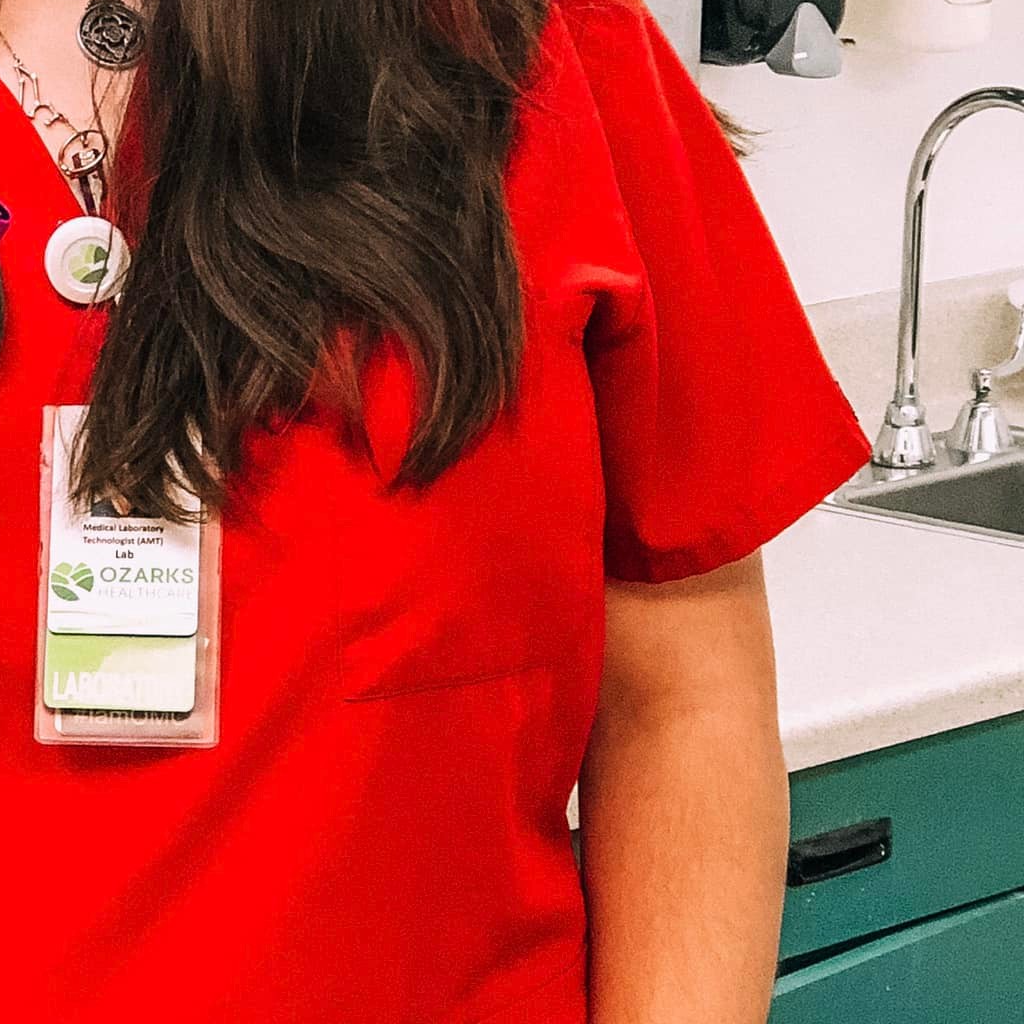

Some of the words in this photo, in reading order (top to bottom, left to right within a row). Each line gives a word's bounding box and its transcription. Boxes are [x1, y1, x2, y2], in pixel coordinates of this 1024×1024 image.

[83, 523, 117, 533] Medical
[118, 524, 165, 534] Laboratory
[83, 536, 135, 546] Technologist
[137, 535, 164, 546] (AMT)
[115, 549, 134, 560] Lab
[99, 566, 195, 585] OZARKS
[97, 587, 193, 601] HEALTHCARE
